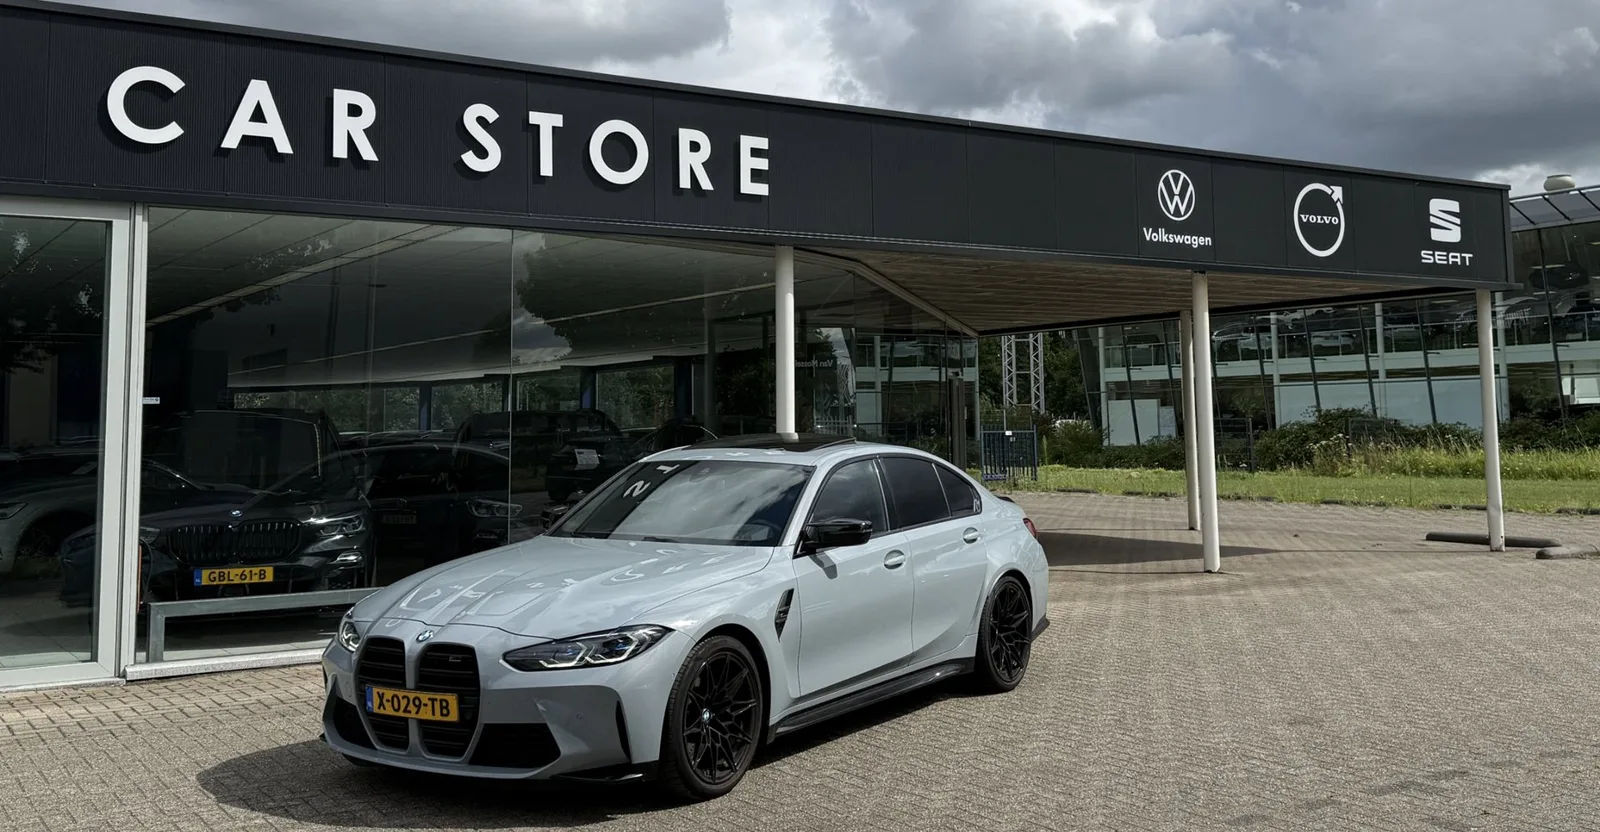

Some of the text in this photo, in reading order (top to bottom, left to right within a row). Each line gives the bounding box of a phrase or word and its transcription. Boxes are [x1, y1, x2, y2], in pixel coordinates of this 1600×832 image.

[106, 65, 769, 196] CAR STORE
[1300, 213, 1339, 225] VOLVO
[1142, 227, 1212, 249] Volkswagen
[1420, 250, 1474, 266] SEAT
[208, 569, 267, 583] GBL-61-B
[376, 691, 450, 717] X-029-TB
